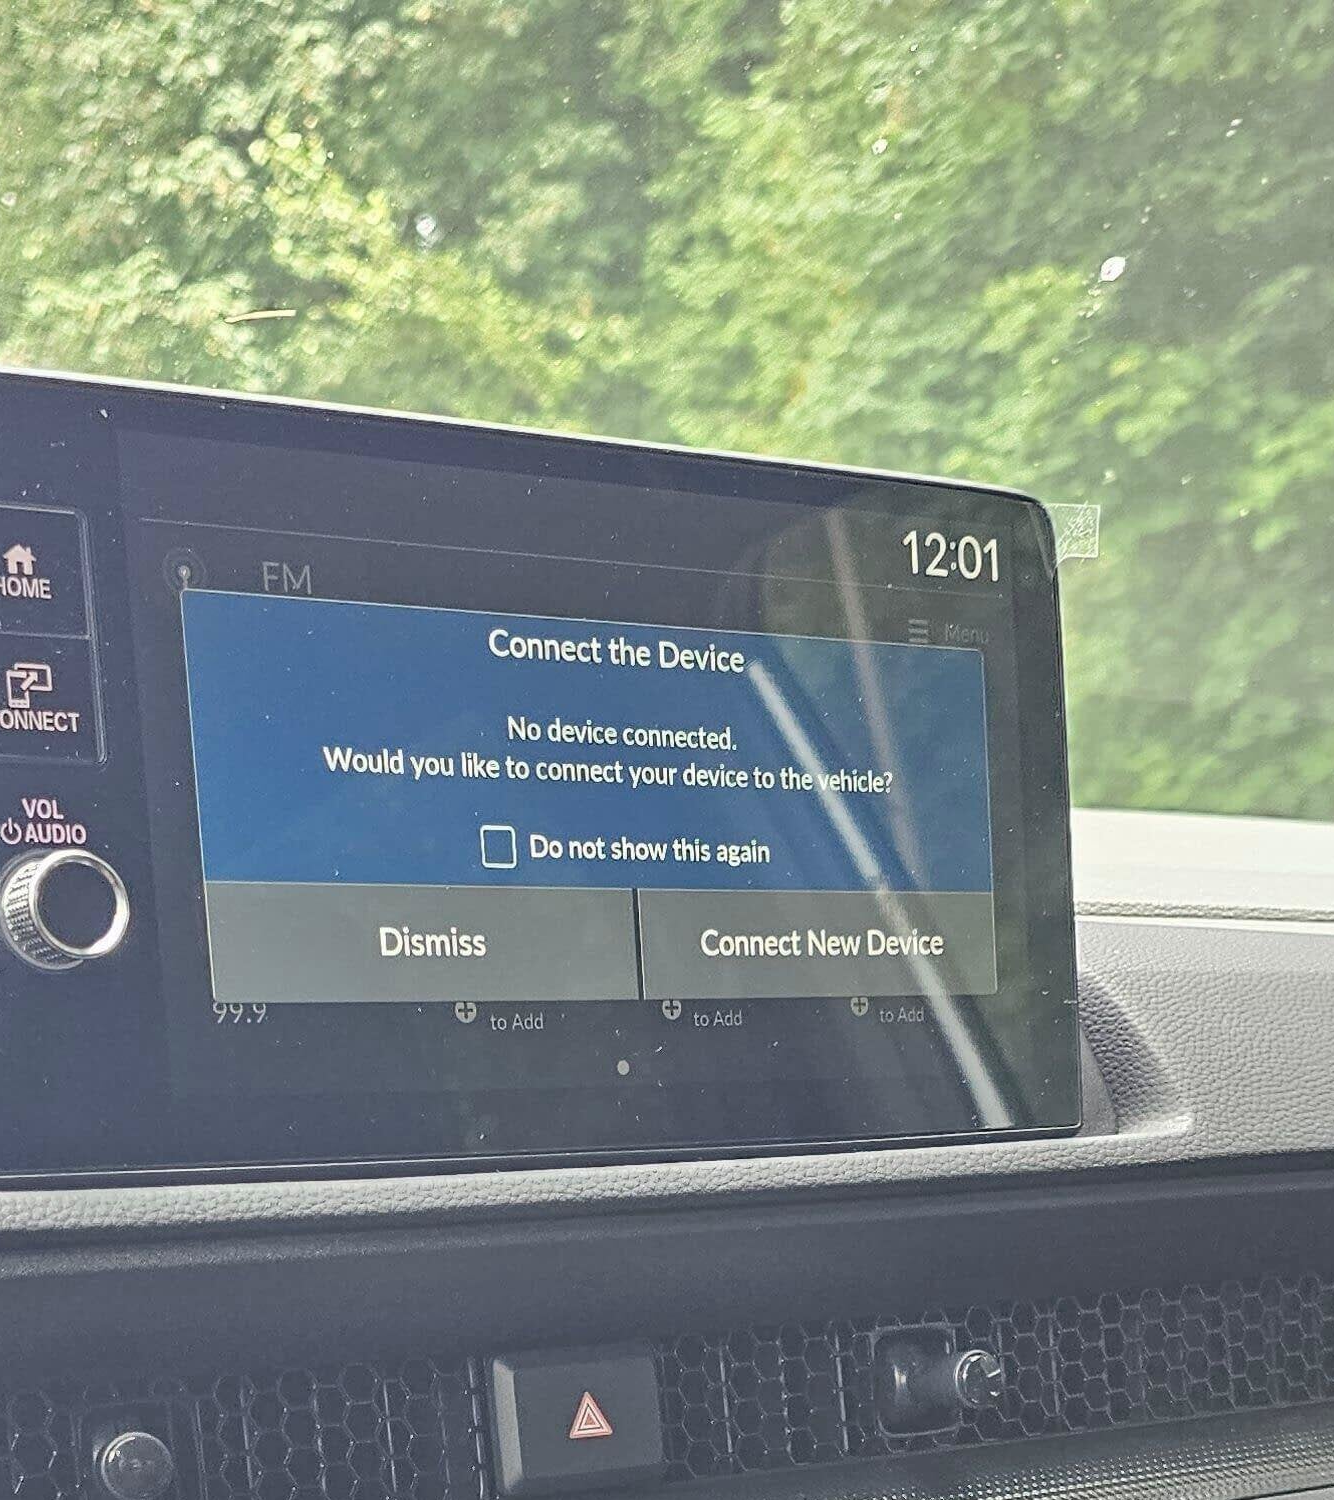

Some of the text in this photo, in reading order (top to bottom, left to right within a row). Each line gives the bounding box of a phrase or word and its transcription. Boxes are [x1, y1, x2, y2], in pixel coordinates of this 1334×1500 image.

[901, 530, 999, 582] 12:01
[261, 561, 313, 594] FM
[487, 628, 746, 674] Connect the Device
[506, 715, 737, 752] No device connected.
[322, 746, 894, 795] Would you like to connect your device to the vehicle?
[21, 798, 65, 820] VOL
[24, 823, 87, 845] AUDIO
[529, 834, 771, 868] Do not show this again
[378, 926, 488, 958] Dismiss
[699, 928, 945, 958] Connect New Device
[213, 1003, 267, 1025] 99.9
[490, 1012, 544, 1031] to Add
[693, 1009, 743, 1027] to Add
[879, 1006, 925, 1024] to Add
